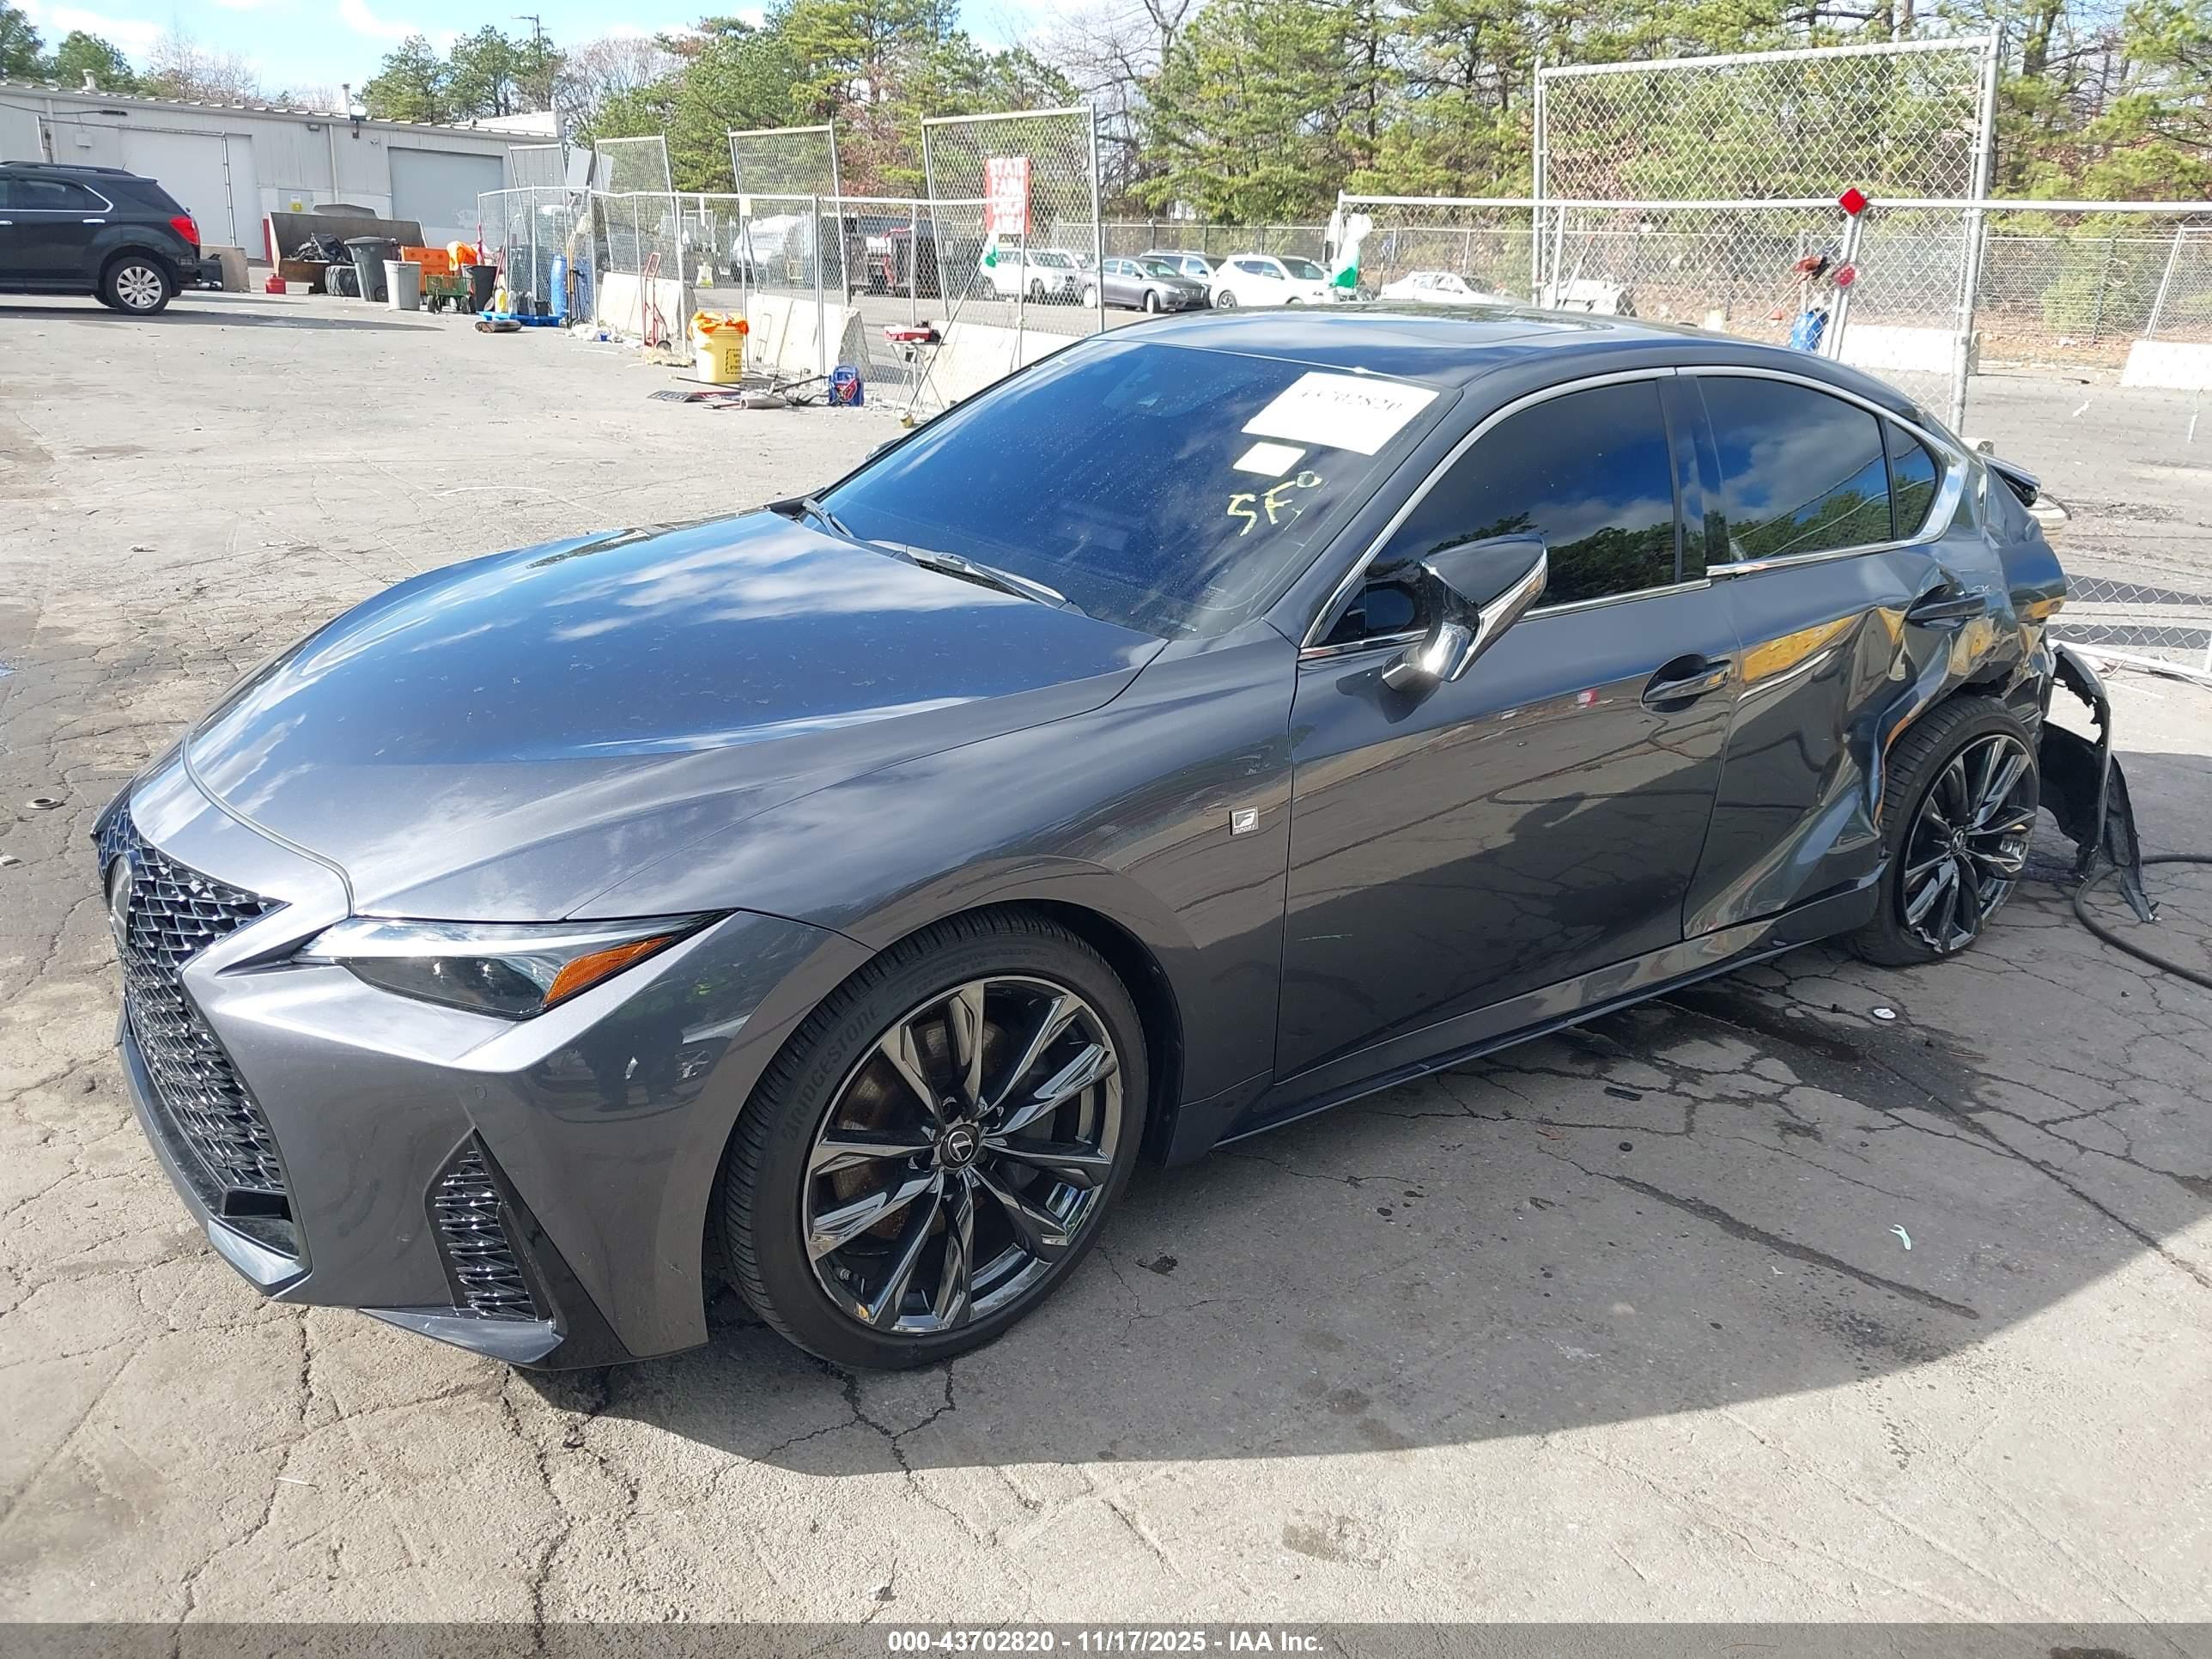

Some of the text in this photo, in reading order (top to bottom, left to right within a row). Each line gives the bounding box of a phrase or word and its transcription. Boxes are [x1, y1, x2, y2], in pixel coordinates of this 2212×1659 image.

[989, 158, 1025, 177] STATE
[992, 177, 1024, 197] FARM
[993, 215, 1024, 234] AREA
[1234, 824, 1256, 835] SPORT
[781, 1001, 880, 1141] BRIDGESTONE
